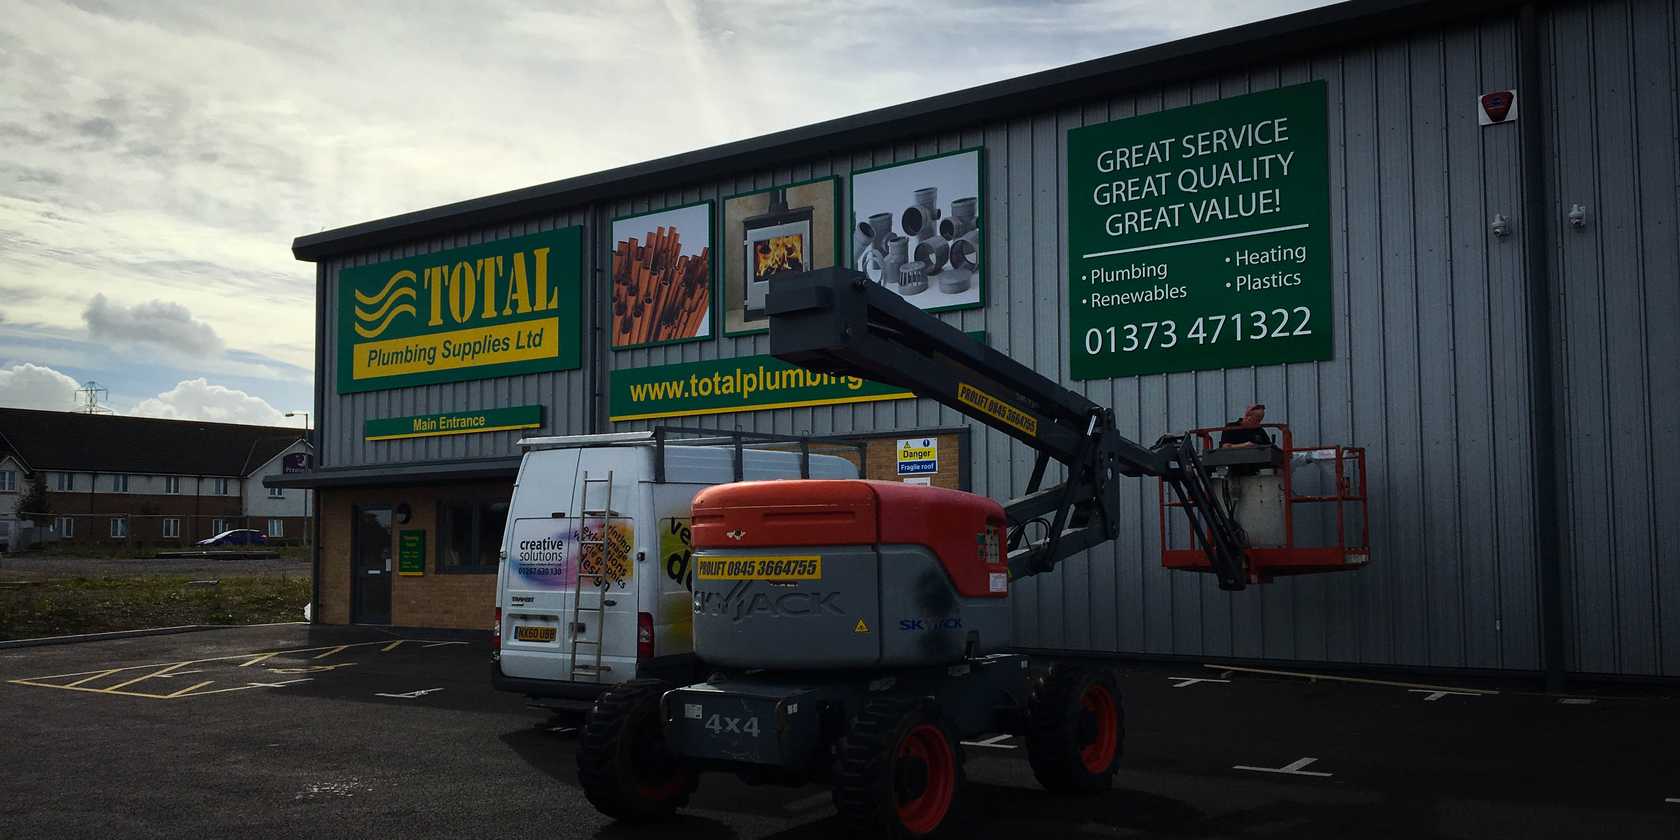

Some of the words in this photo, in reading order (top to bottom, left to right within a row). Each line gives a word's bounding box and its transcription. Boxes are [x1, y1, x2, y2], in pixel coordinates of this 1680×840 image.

[1096, 138, 1176, 174] GREAT
[1181, 117, 1290, 159] SERVICE
[1093, 171, 1172, 206] GREAT
[1177, 151, 1295, 193] QUALITY
[1105, 203, 1185, 237] GREAT
[1189, 188, 1281, 225] VALUE!
[1235, 245, 1307, 267] Heating
[1091, 263, 1169, 285] Plumbing
[1236, 271, 1302, 292] Plastics
[423, 247, 559, 328] TOTAL
[1091, 284, 1188, 309] Renewables
[1085, 319, 1178, 355] 01373
[1186, 306, 1313, 345] 471322
[367, 344, 436, 368] Plumbing
[441, 335, 510, 361] Supplies
[515, 327, 544, 350] Ltd
[413, 417, 436, 432] Main
[439, 414, 486, 430] Entrance
[903, 450, 931, 460] Danger
[920, 463, 934, 471] roof
[519, 537, 564, 551] creative
[519, 551, 563, 562] solutions
[699, 560, 727, 577] PROLIFT
[727, 560, 756, 577] 0845
[757, 559, 817, 577] 3664755
[705, 713, 761, 737] 4x4
